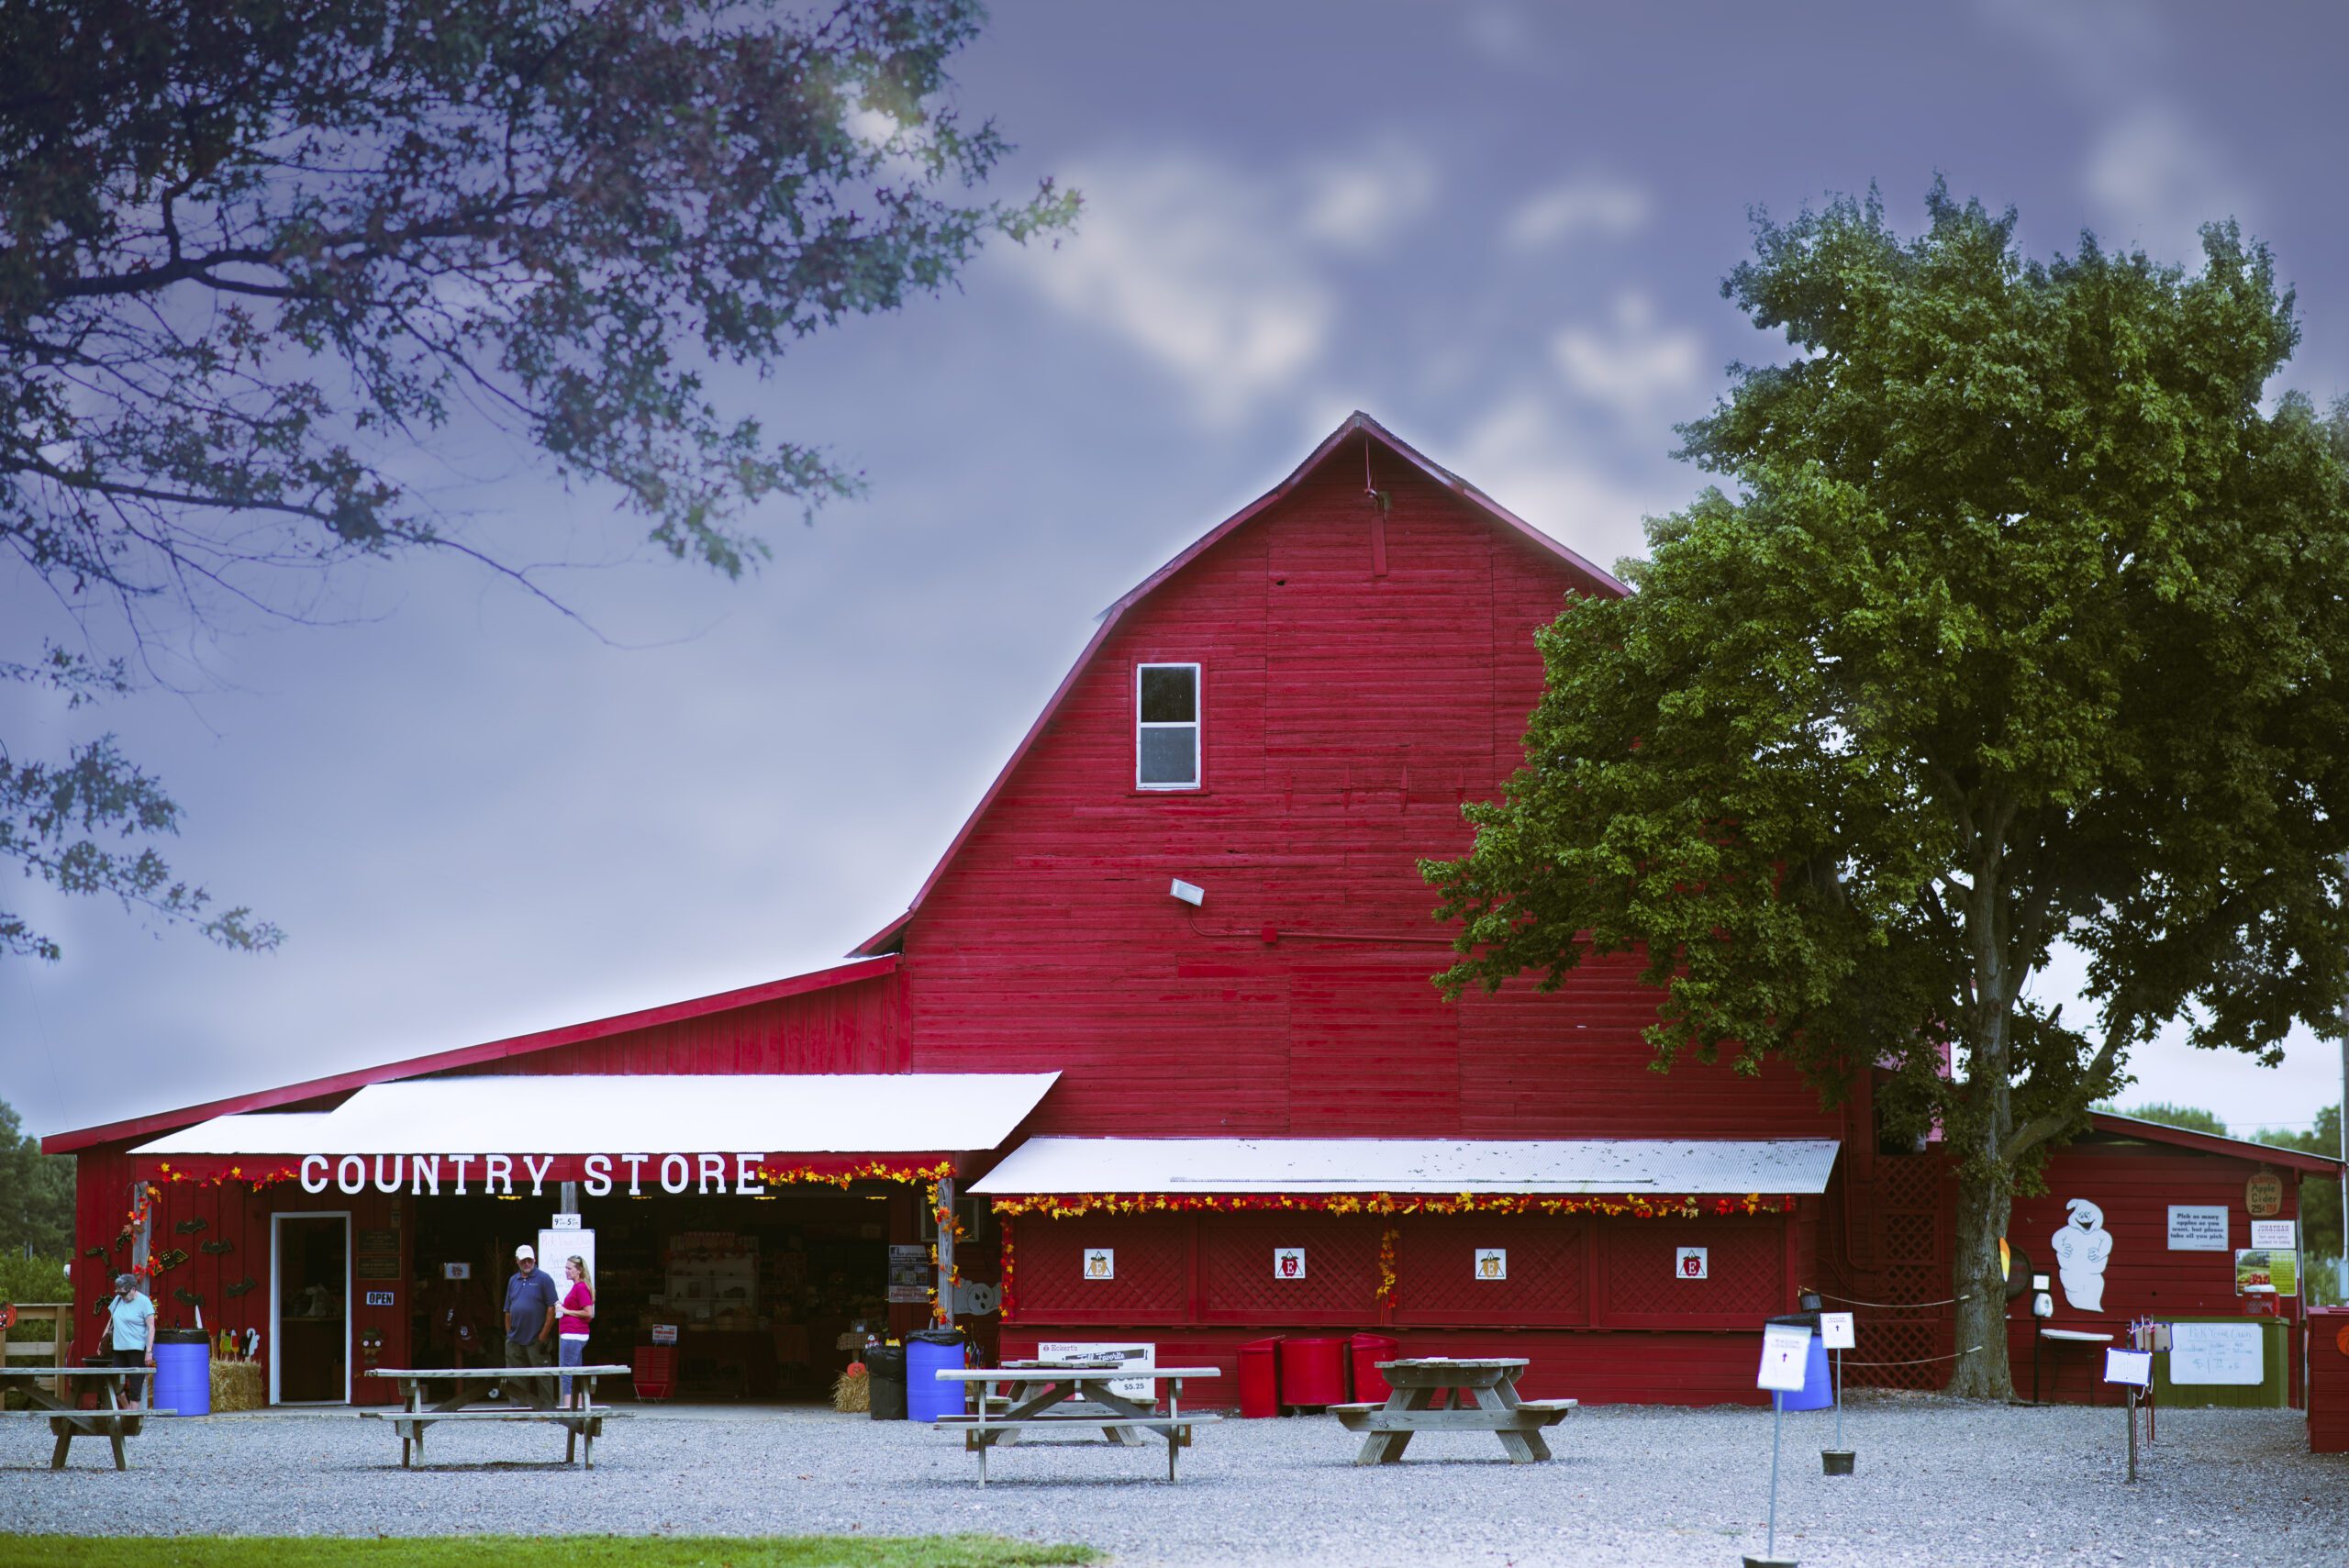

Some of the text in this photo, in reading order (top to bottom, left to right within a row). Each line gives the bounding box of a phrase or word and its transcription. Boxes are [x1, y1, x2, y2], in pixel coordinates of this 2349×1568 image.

[301, 1153, 764, 1196] COUNTRY STORE
[2251, 1184, 2276, 1195] Apple
[2252, 1193, 2277, 1203] Cider
[554, 1218, 559, 1226] 9
[567, 1218, 572, 1226] 5
[1095, 1262, 1103, 1275] E
[1286, 1261, 1295, 1274] E
[1487, 1262, 1496, 1276] E
[1688, 1261, 1697, 1274] E
[369, 1293, 392, 1304] OPEN
[1095, 1351, 1126, 1362] Favorite
[1124, 1383, 1145, 1391] $5.25
